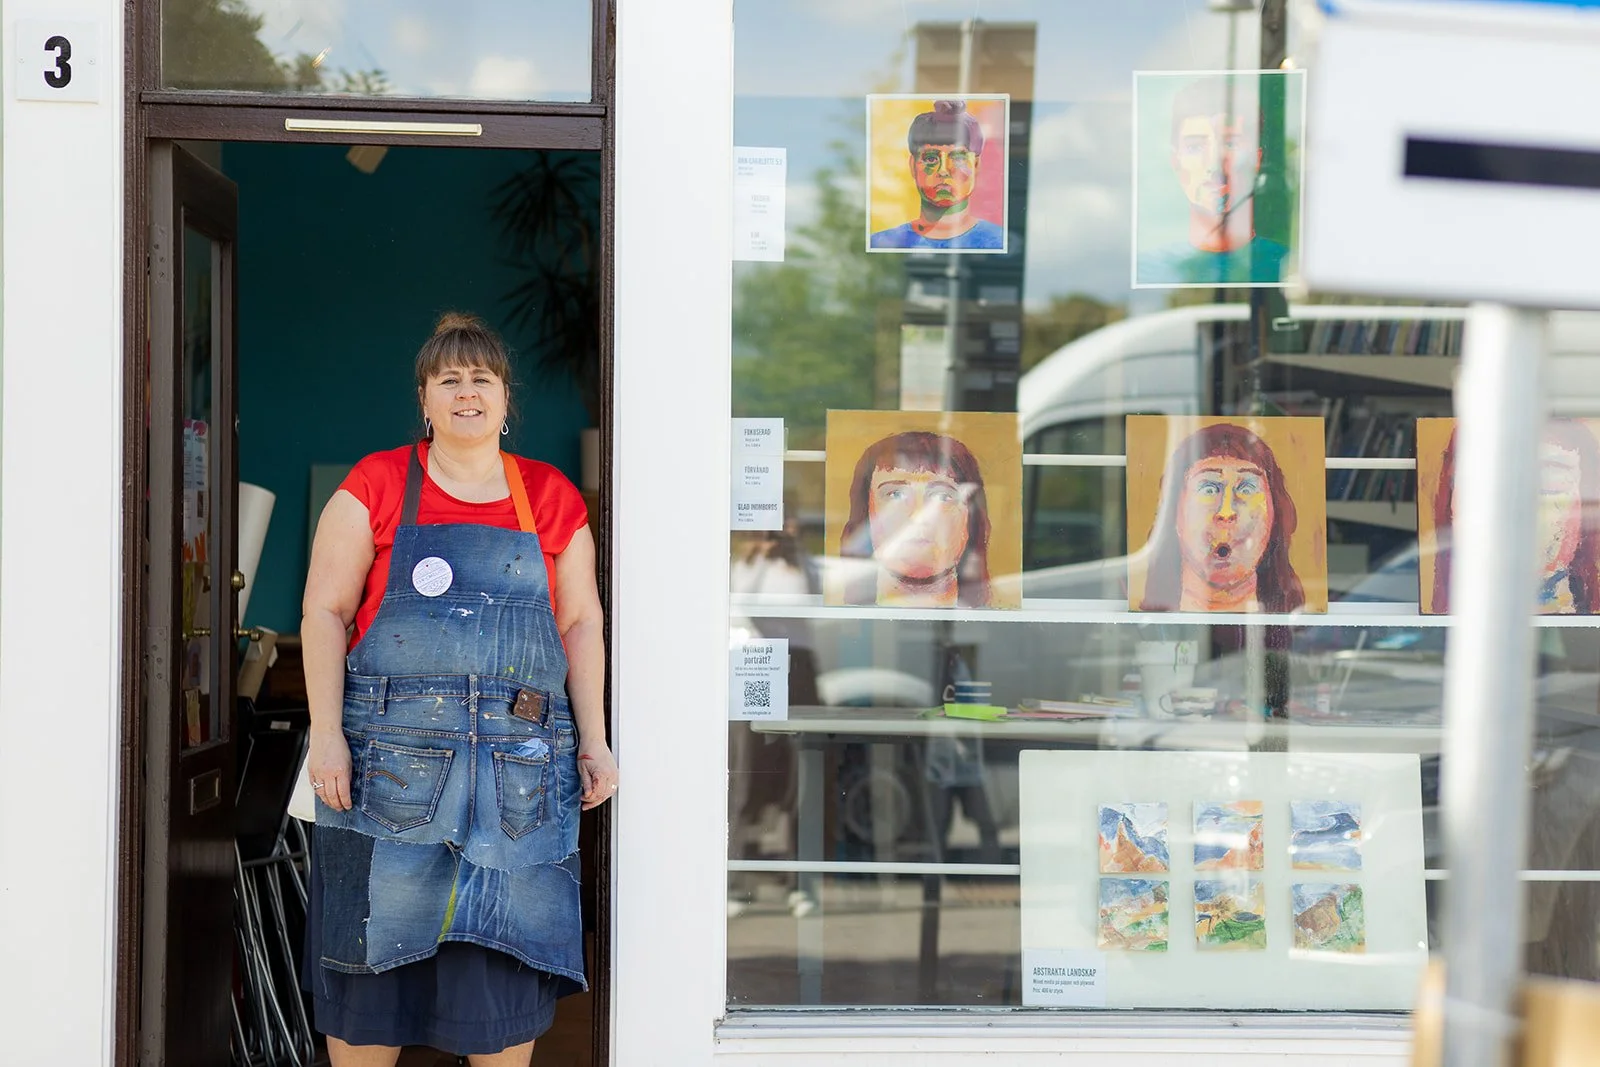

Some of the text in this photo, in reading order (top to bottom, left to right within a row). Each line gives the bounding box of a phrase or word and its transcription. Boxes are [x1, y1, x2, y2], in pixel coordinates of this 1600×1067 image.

[44, 35, 72, 89] 3
[744, 428, 771, 436] FOKUSERAD
[744, 465, 769, 474] FÖRVÅNAD
[765, 644, 773, 655] på
[744, 655, 771, 666] porträtt?
[1033, 967, 1097, 977] ABSTRAKTA LANDSKAP
